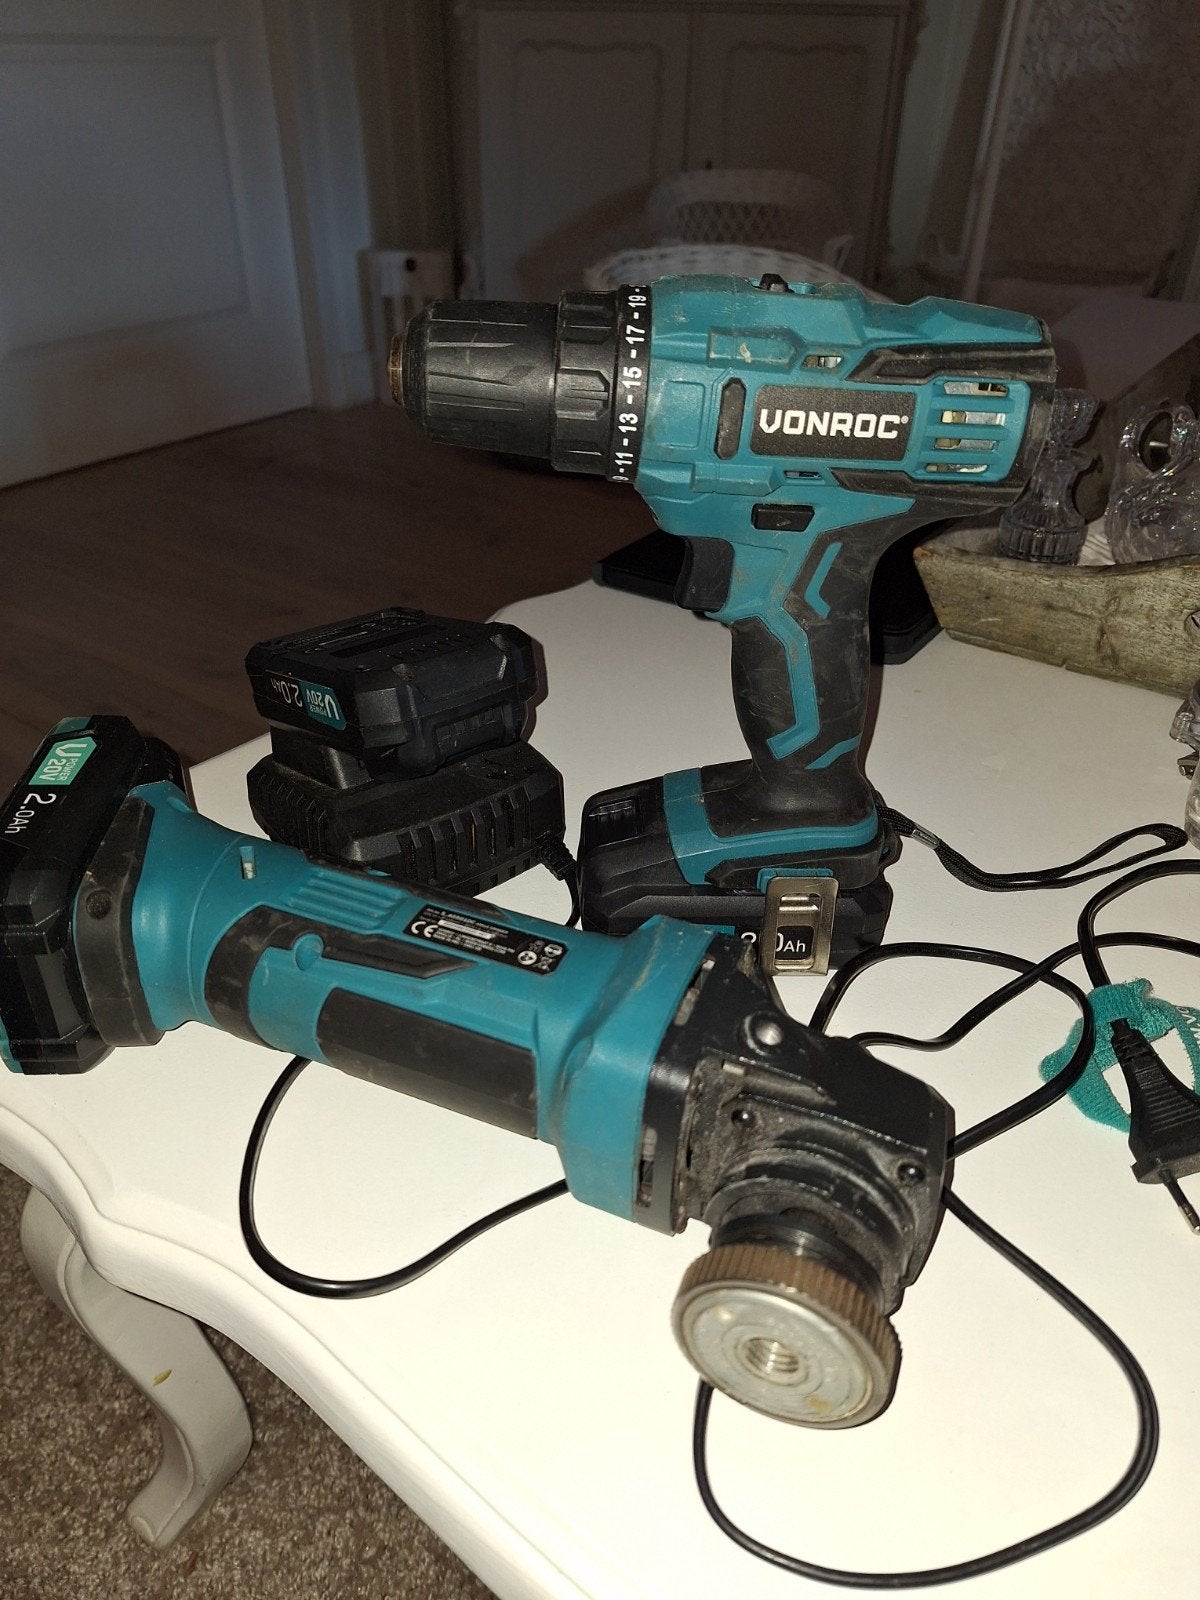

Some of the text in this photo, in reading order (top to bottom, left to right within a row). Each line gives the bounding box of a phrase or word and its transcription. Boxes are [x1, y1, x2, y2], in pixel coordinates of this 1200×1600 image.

[628, 295, 647, 308] 19
[625, 324, 646, 345] 17
[621, 366, 643, 389] 15
[618, 413, 639, 433] 13
[39, 758, 67, 781] 20V
[59, 757, 79, 781] POWER
[4, 793, 57, 834] 2.0Ah
[410, 921, 439, 938] CE
